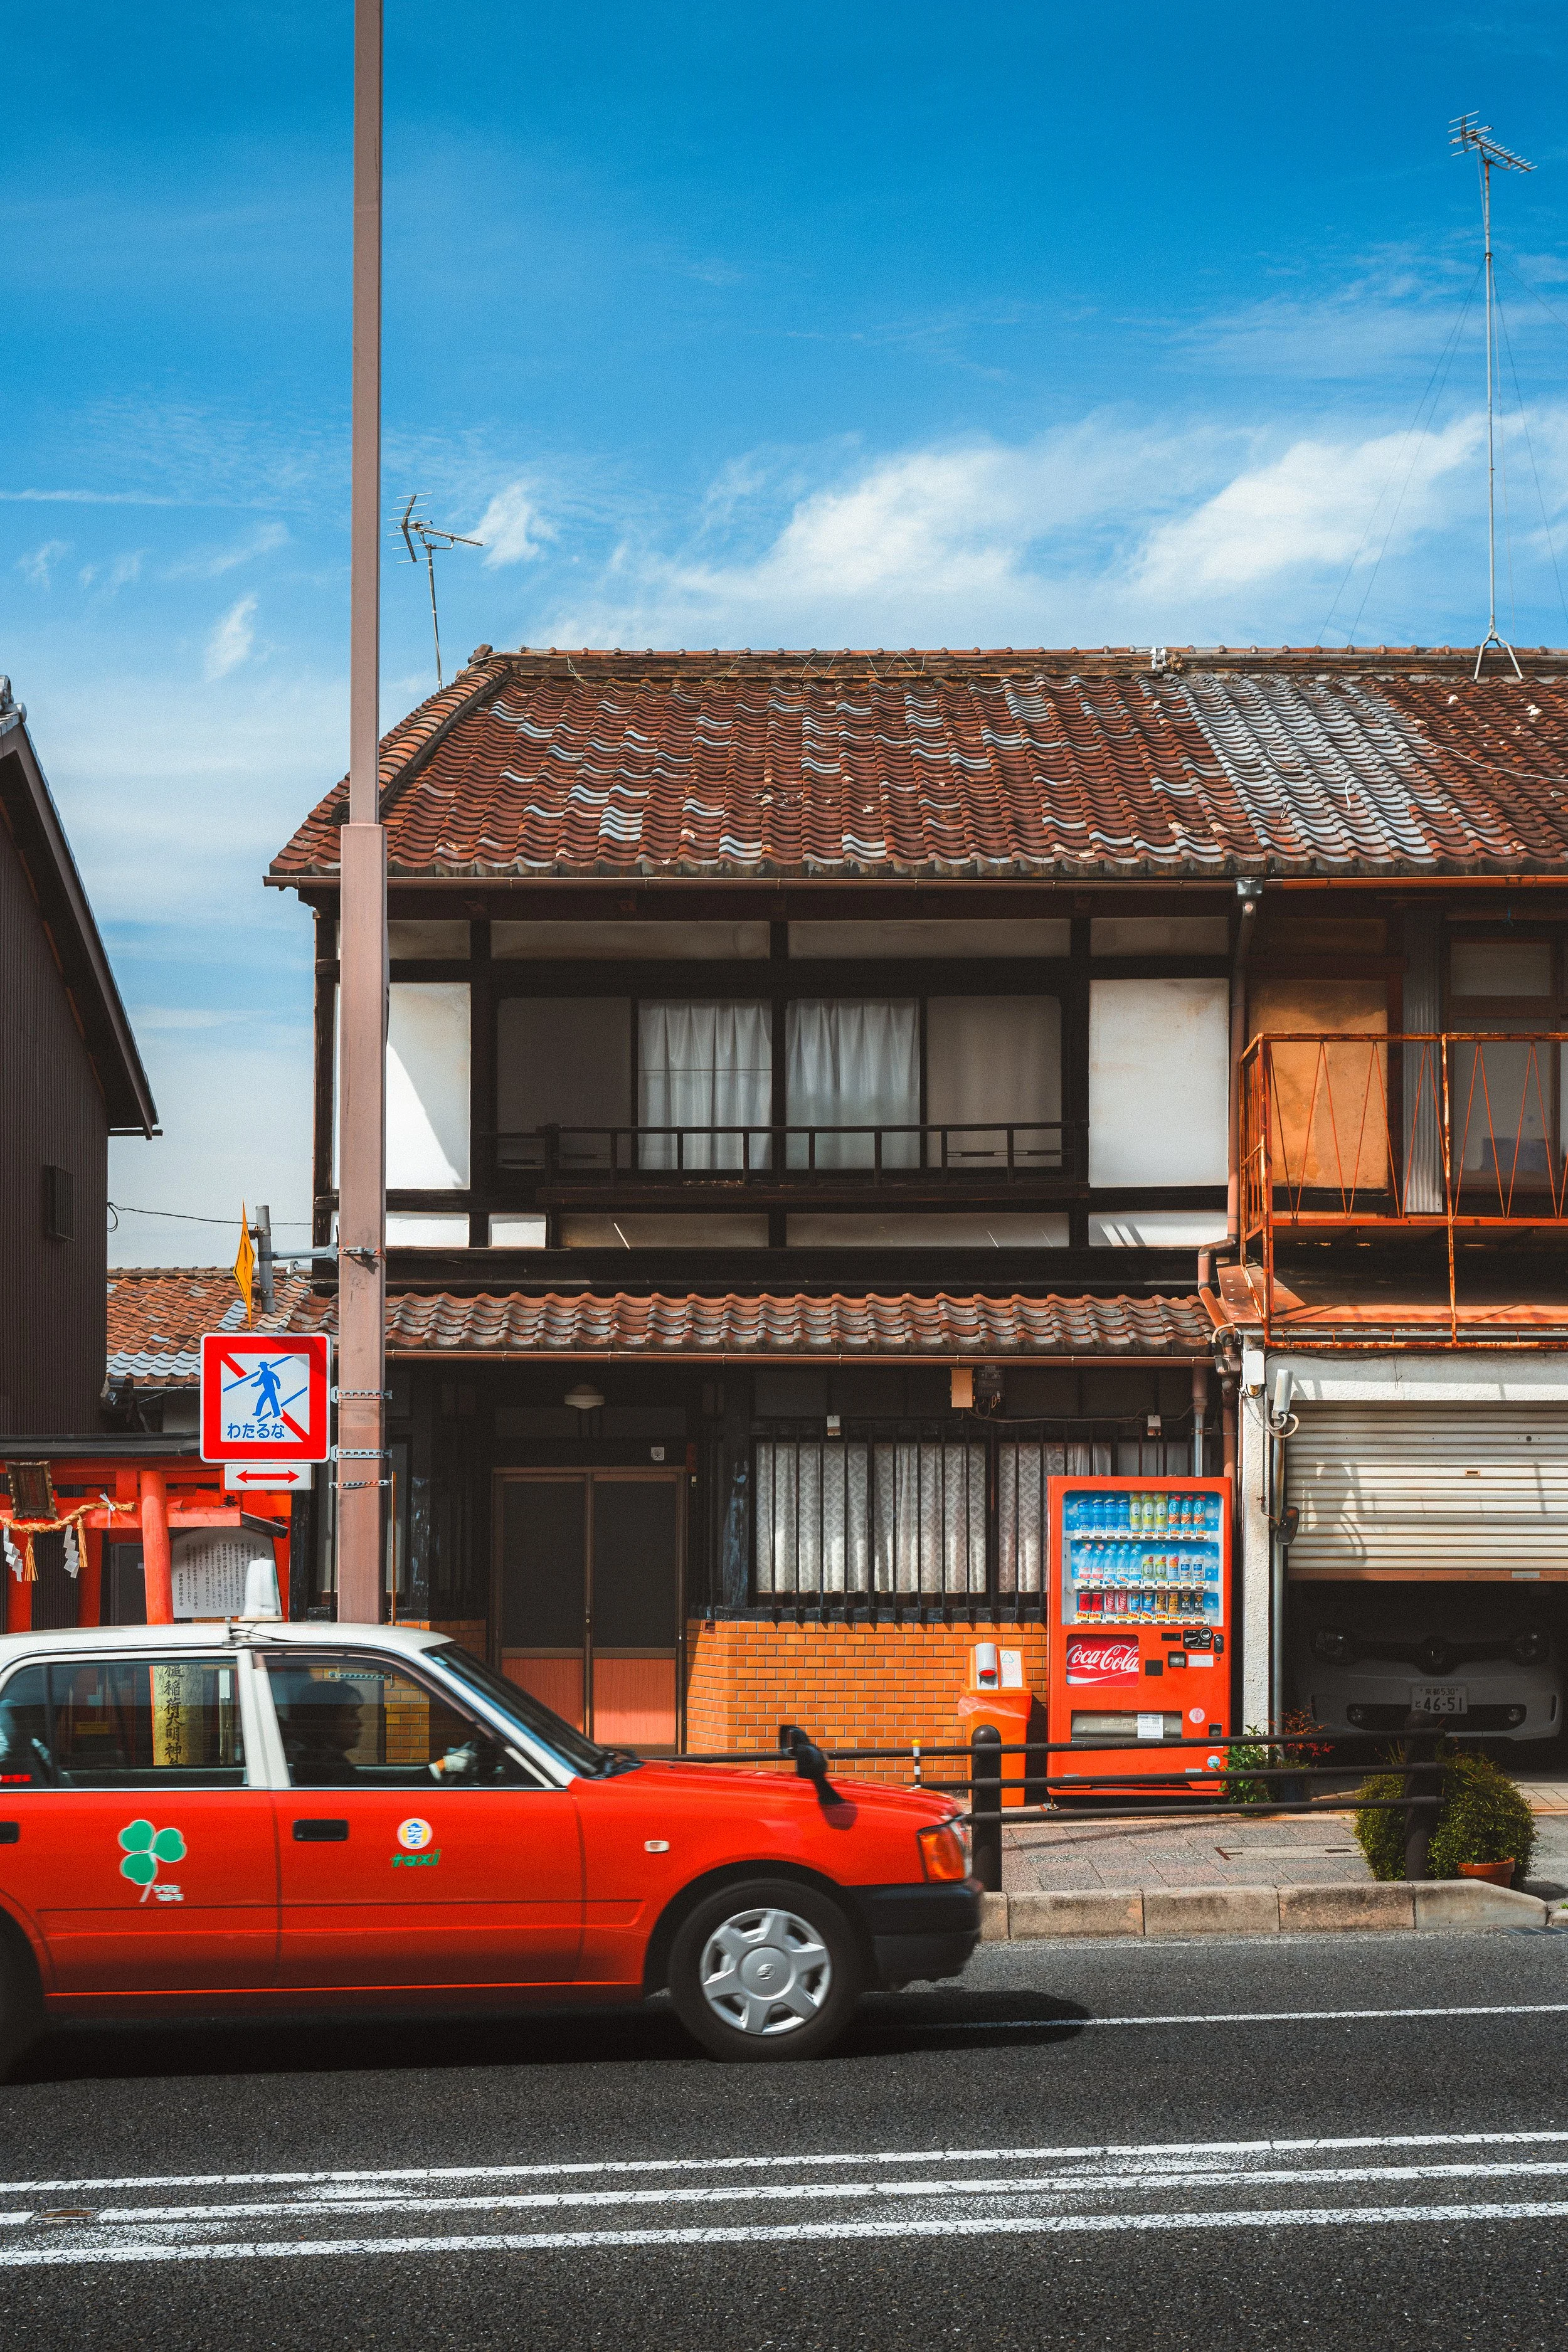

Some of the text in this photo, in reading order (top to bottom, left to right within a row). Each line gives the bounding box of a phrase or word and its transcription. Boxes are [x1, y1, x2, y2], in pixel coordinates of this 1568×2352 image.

[227, 1423, 285, 1439] わたるな
[1066, 1645, 1139, 1670] Coca-Cola
[1424, 1697, 1462, 1712] 46-51
[390, 1849, 441, 1868] taxi
